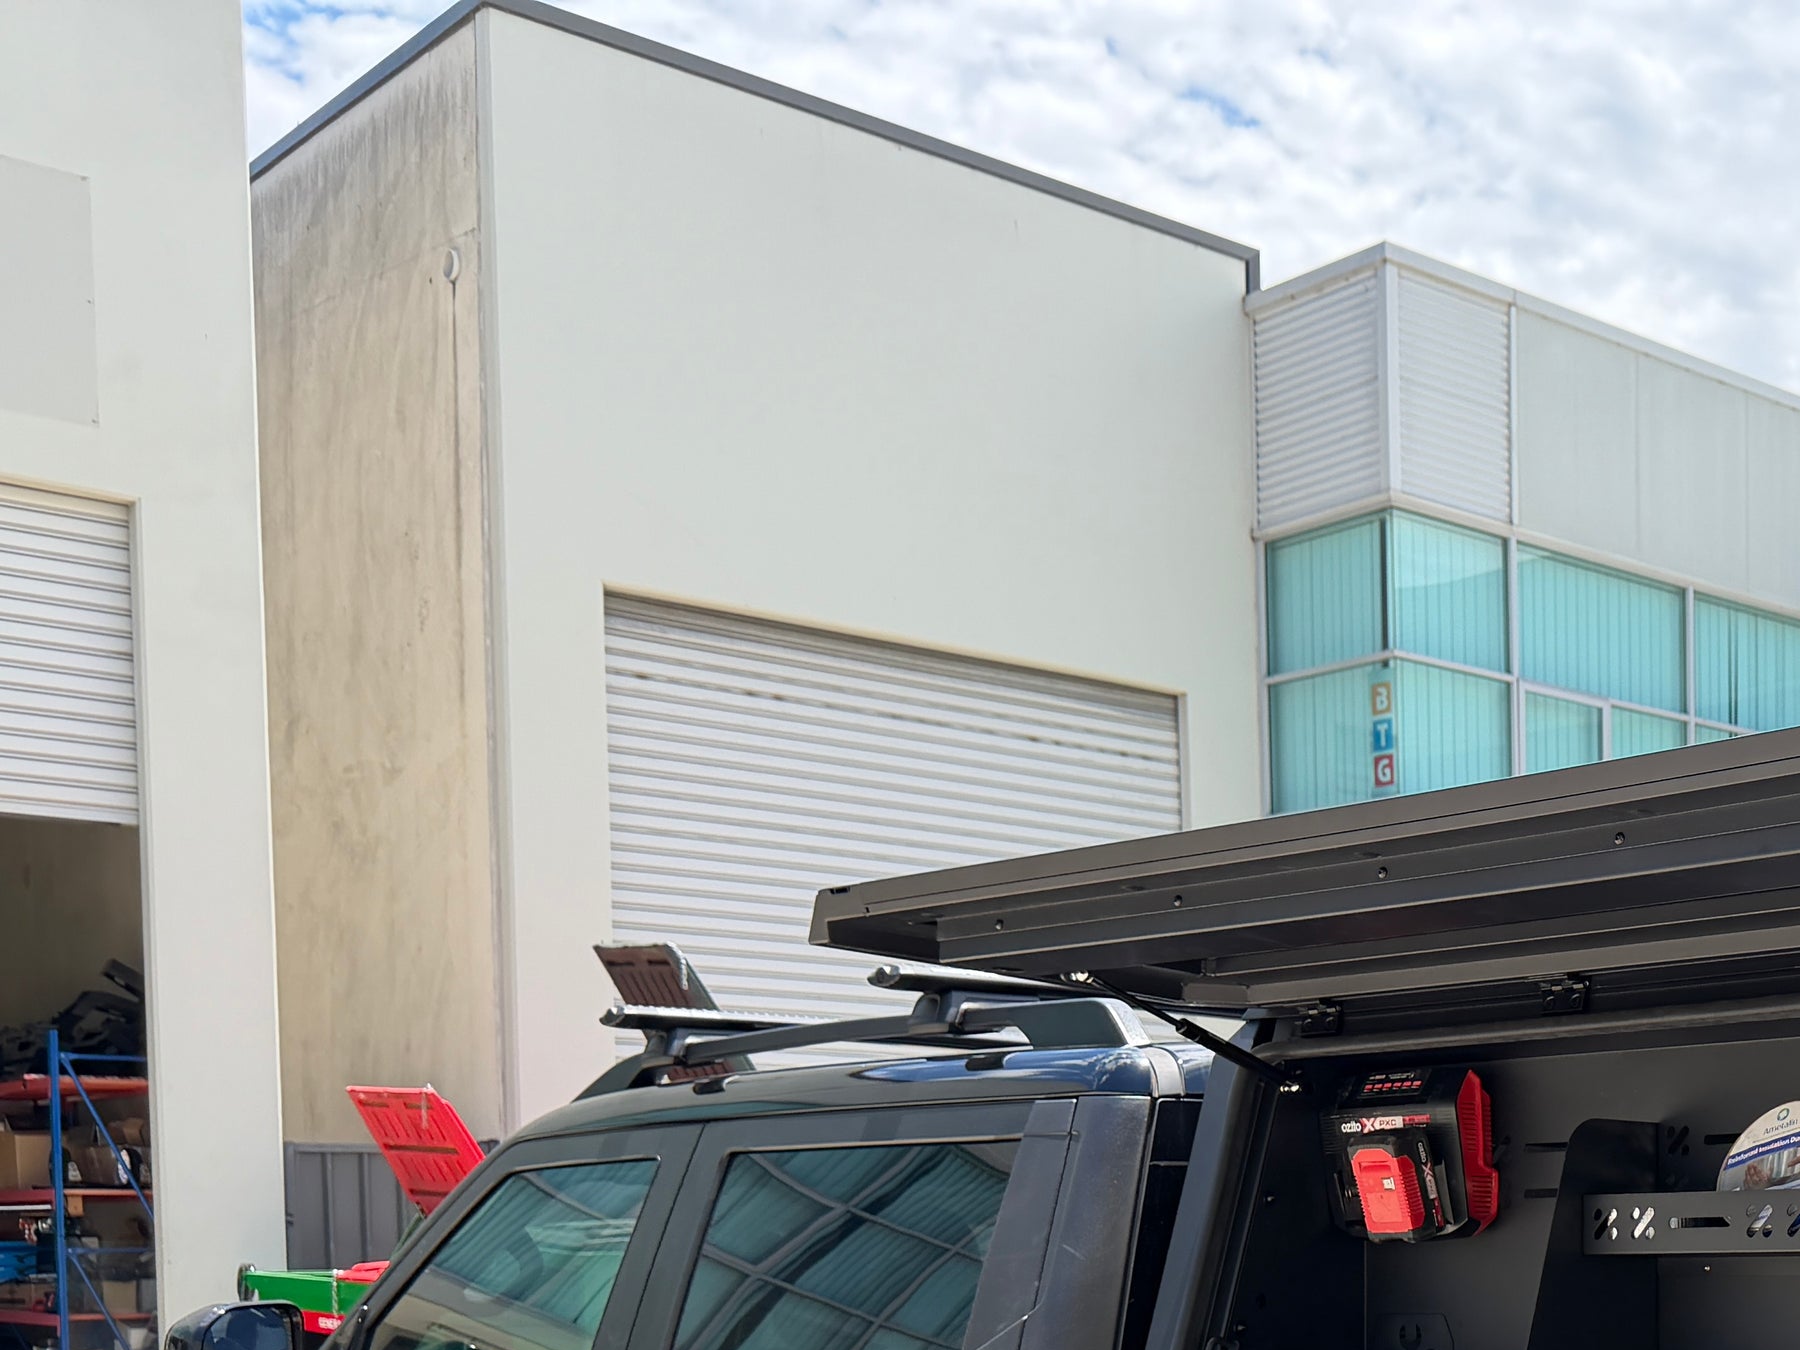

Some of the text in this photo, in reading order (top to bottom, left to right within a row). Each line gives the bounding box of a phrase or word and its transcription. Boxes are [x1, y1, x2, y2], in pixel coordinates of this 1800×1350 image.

[1341, 1120, 1361, 1133] ozito
[1728, 1147, 1758, 1165] Reinforced
[1759, 1138, 1790, 1153] Insulation
